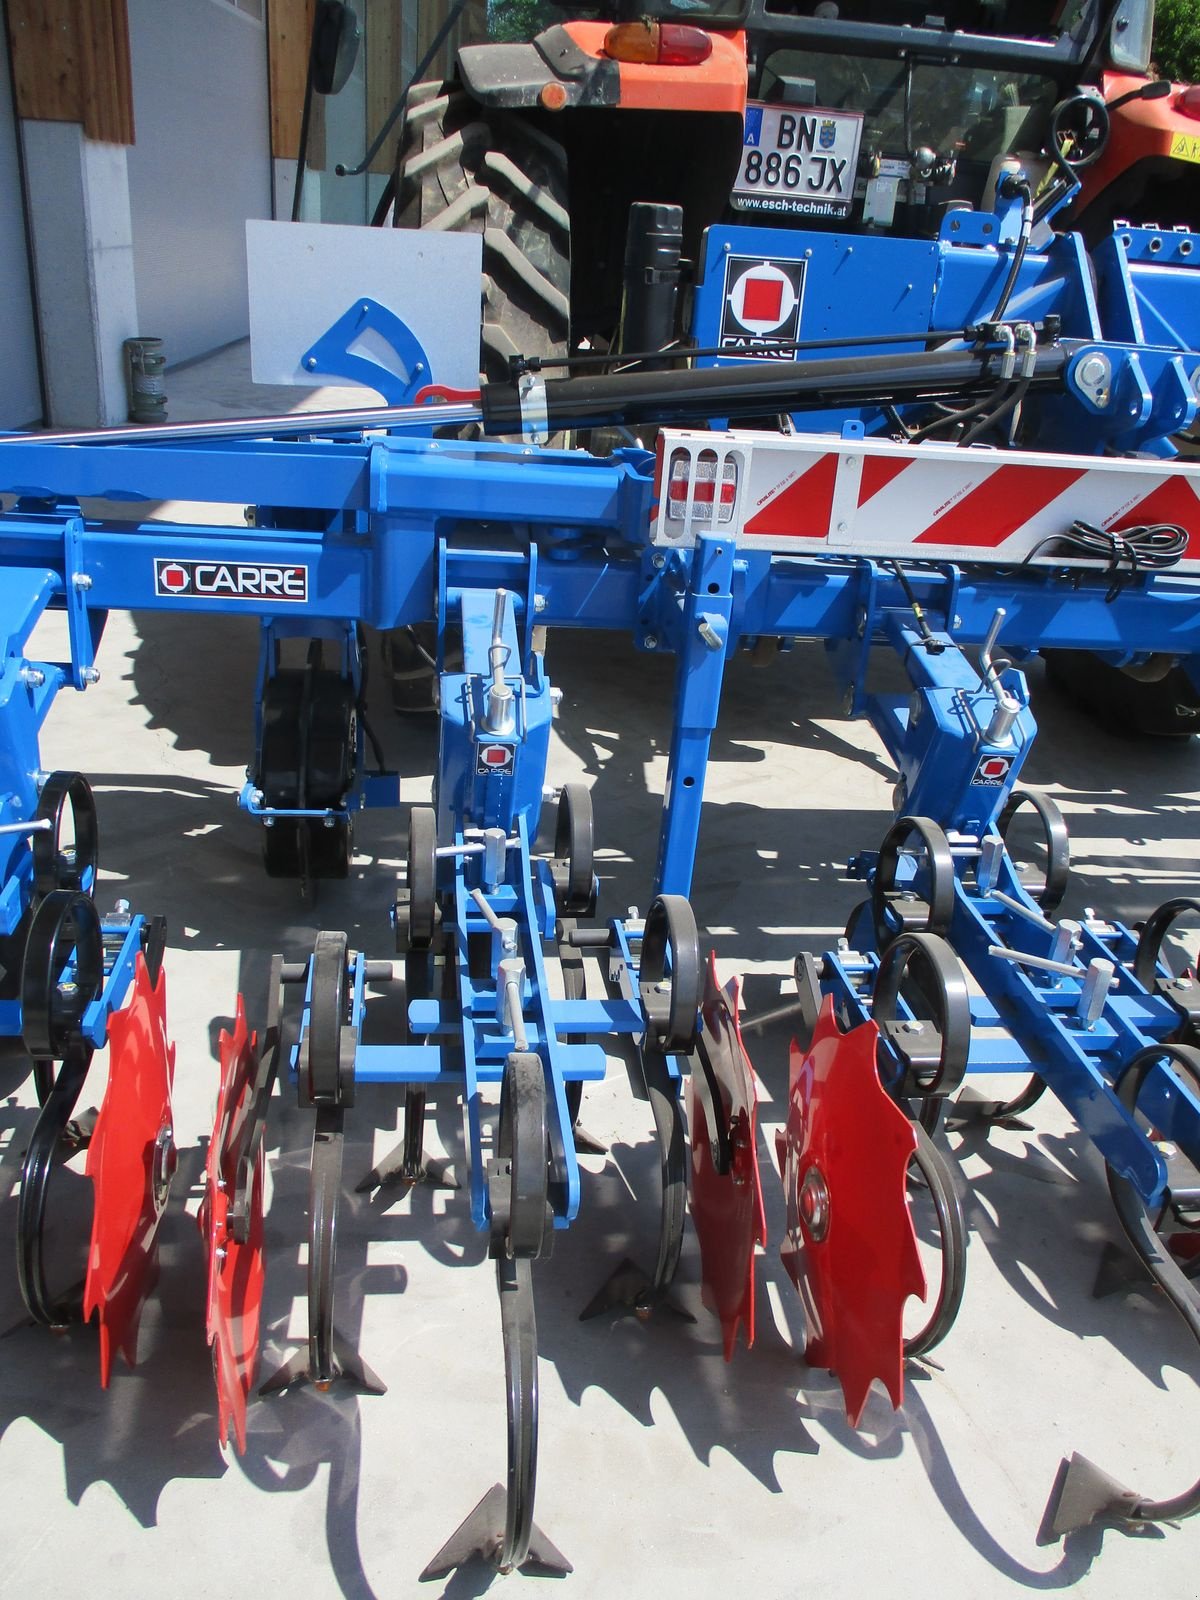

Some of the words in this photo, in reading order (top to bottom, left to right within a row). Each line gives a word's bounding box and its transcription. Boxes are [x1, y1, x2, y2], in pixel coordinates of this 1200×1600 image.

[747, 133, 755, 144] A
[777, 113, 817, 153] BN
[744, 150, 802, 188] 886
[807, 156, 847, 193] JX
[737, 198, 847, 217] www.esch-technik.at
